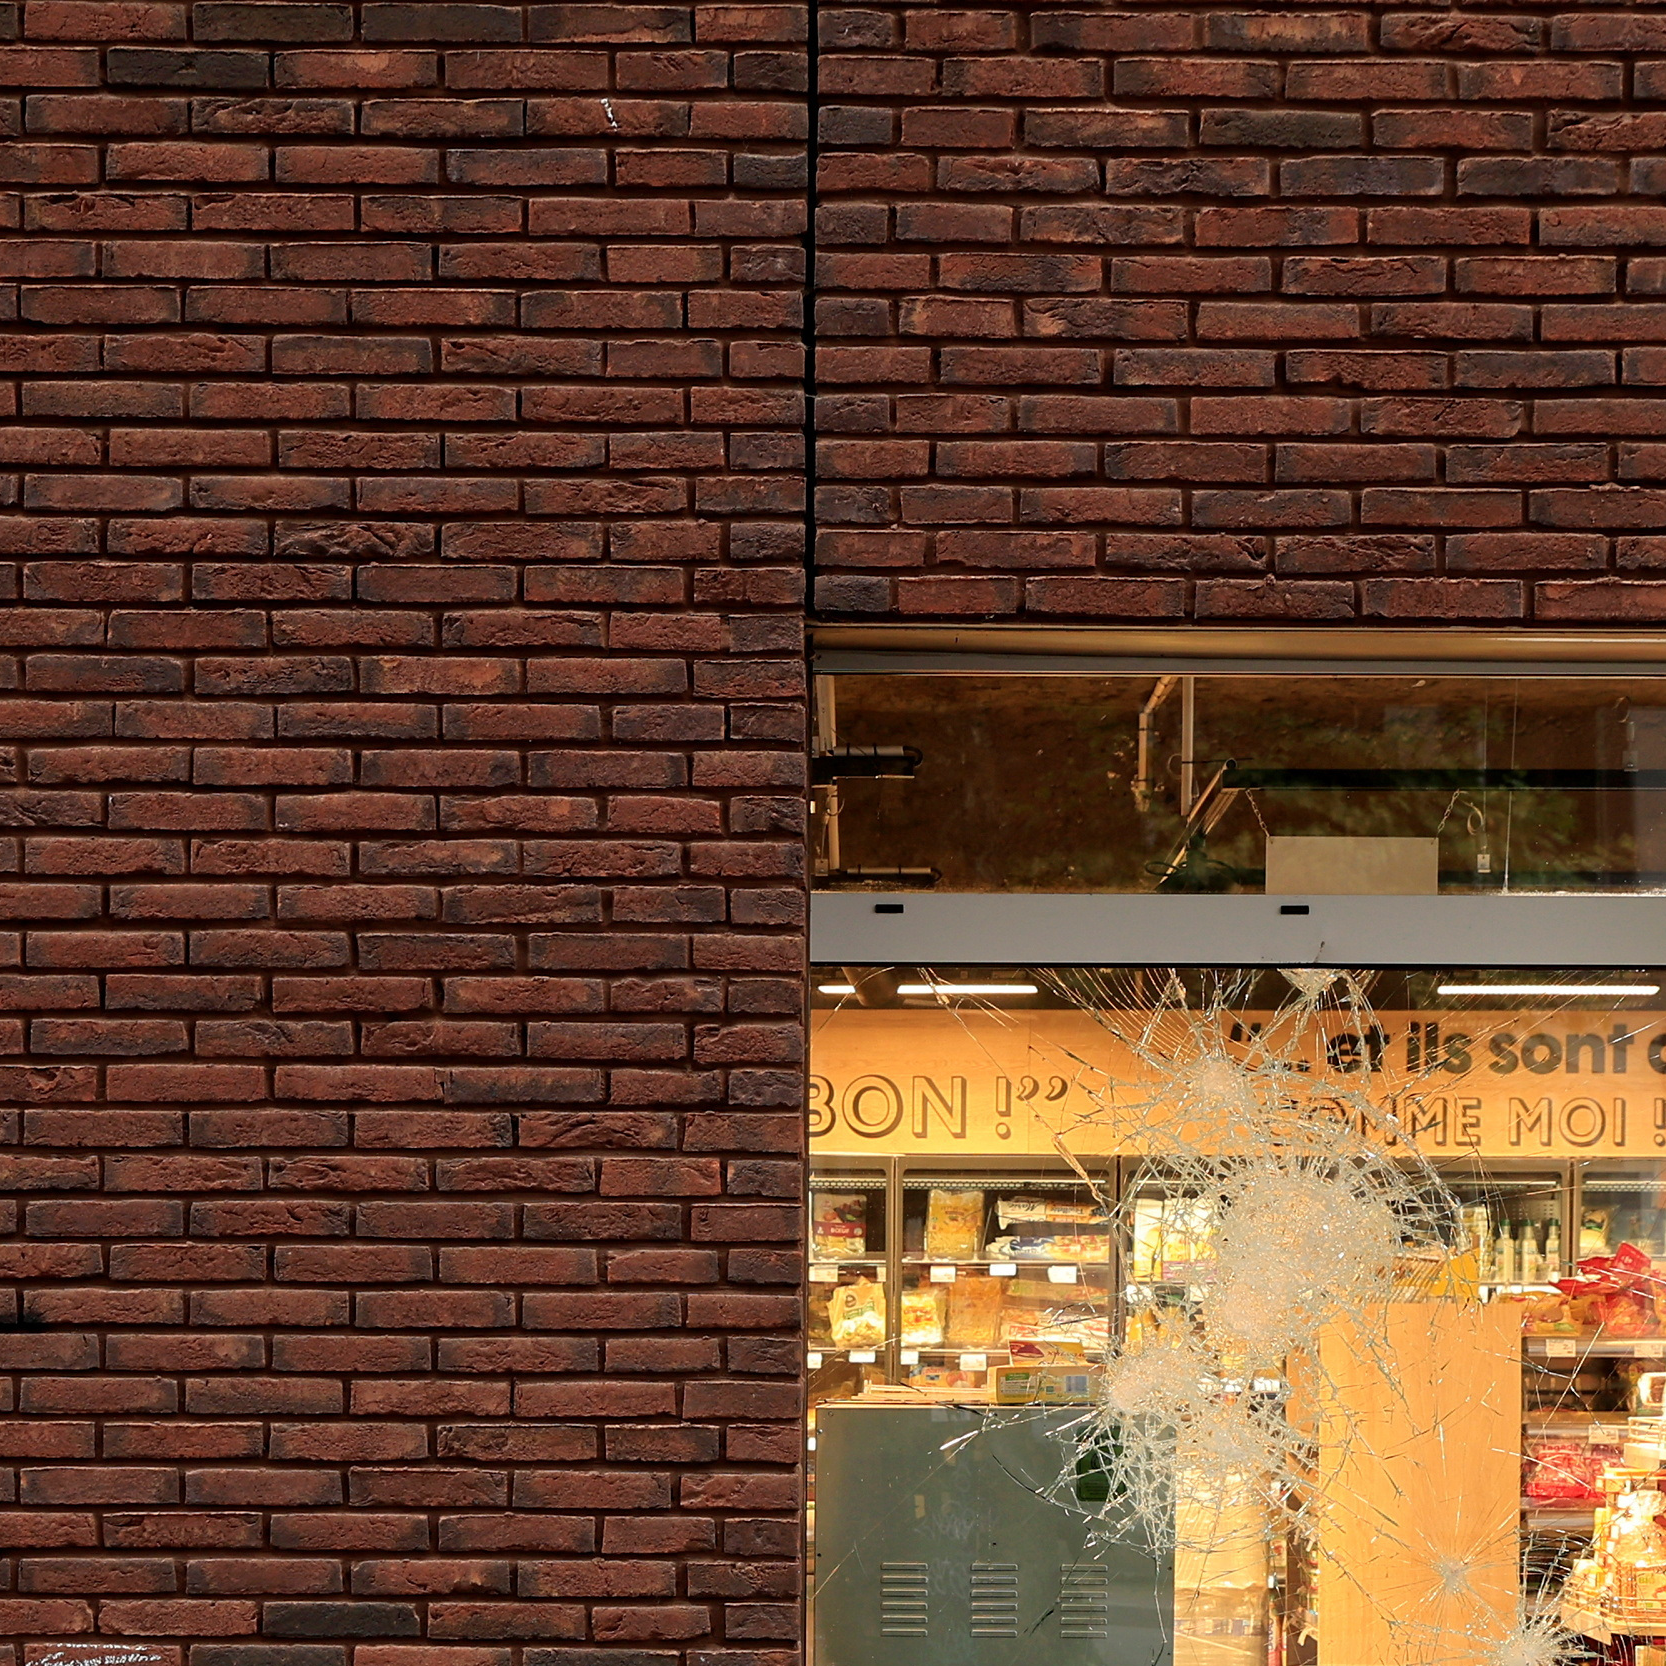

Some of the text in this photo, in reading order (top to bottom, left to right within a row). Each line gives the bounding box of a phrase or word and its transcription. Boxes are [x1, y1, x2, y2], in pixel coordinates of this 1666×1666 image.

[1407, 1021, 1473, 1075] ils
[1488, 1025, 1639, 1075] sont
[1507, 1096, 1625, 1147] MOI
